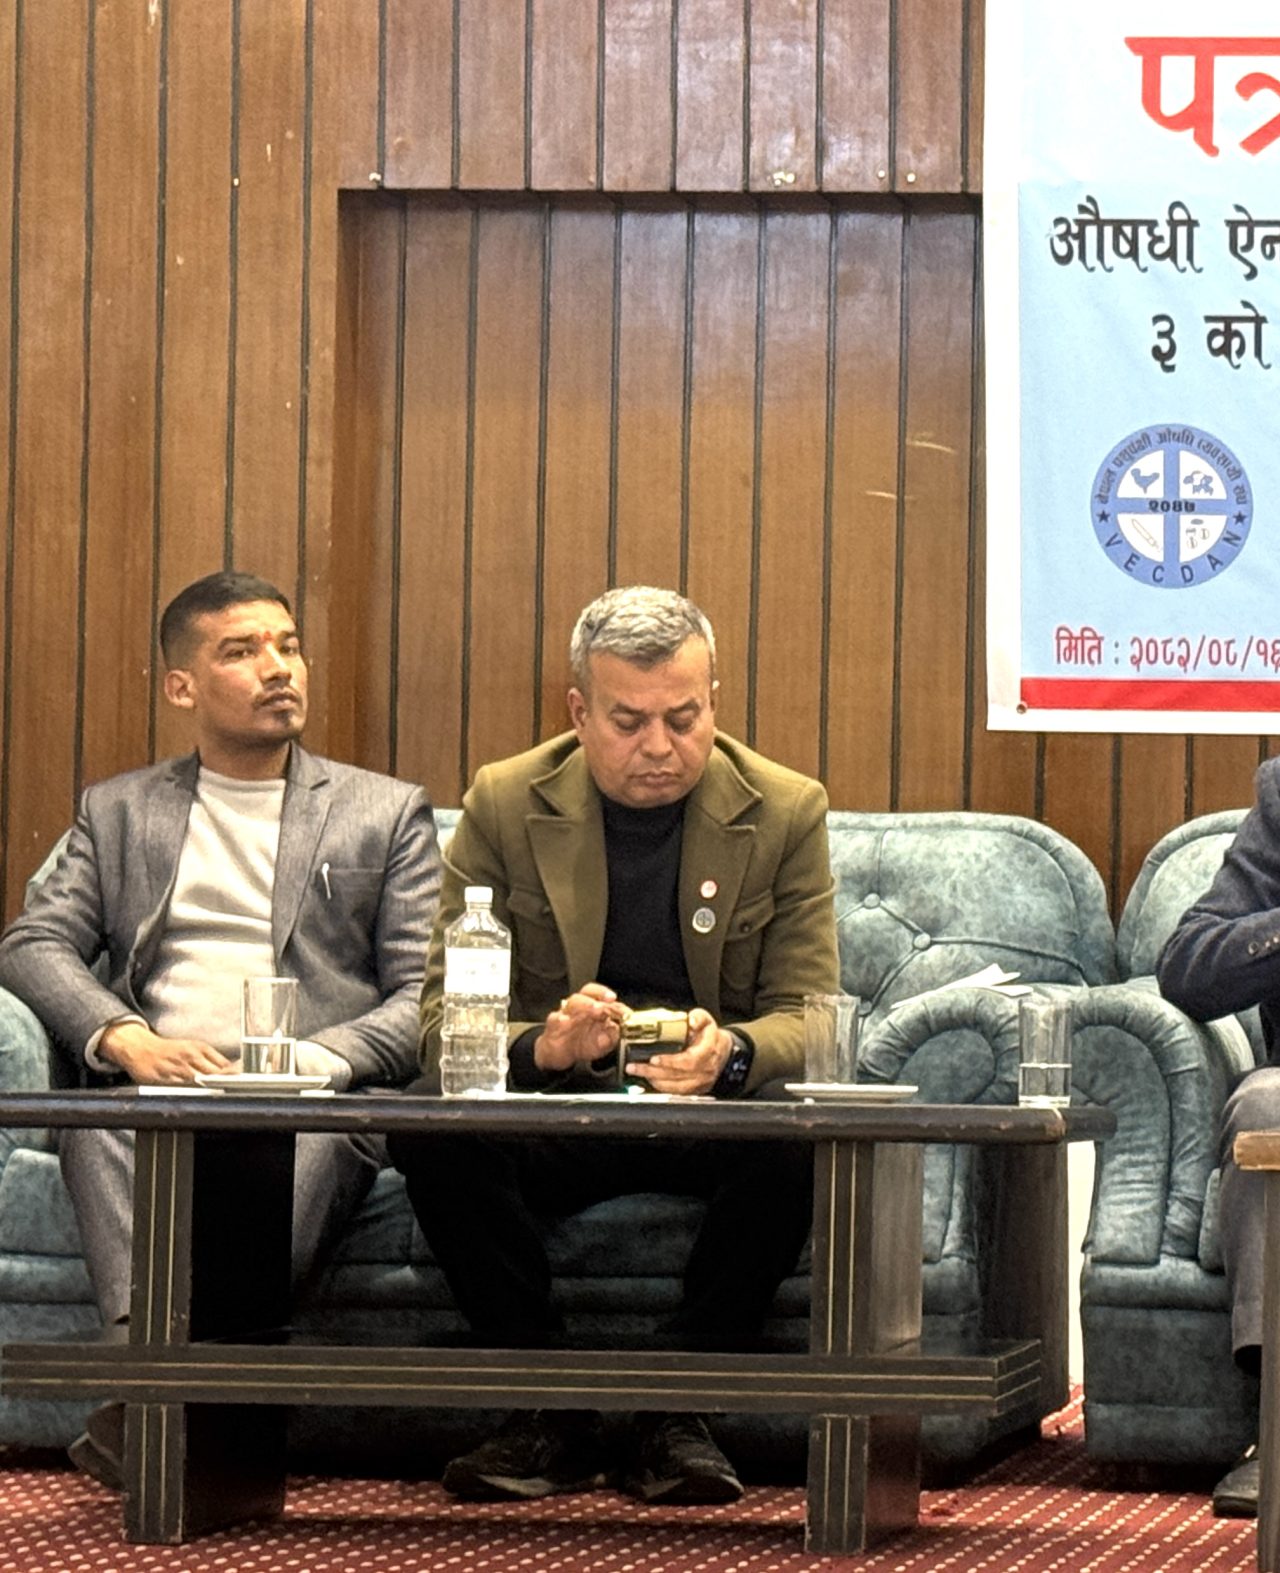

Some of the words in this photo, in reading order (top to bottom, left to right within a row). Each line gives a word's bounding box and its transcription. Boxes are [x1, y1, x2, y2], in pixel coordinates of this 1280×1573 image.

[1049, 195, 1203, 274] औषधी
[1151, 314, 1177, 373] ३
[1203, 300, 1272, 370] को
[1105, 532, 1242, 584] VECDAN
[1055, 625, 1105, 666] मिति
